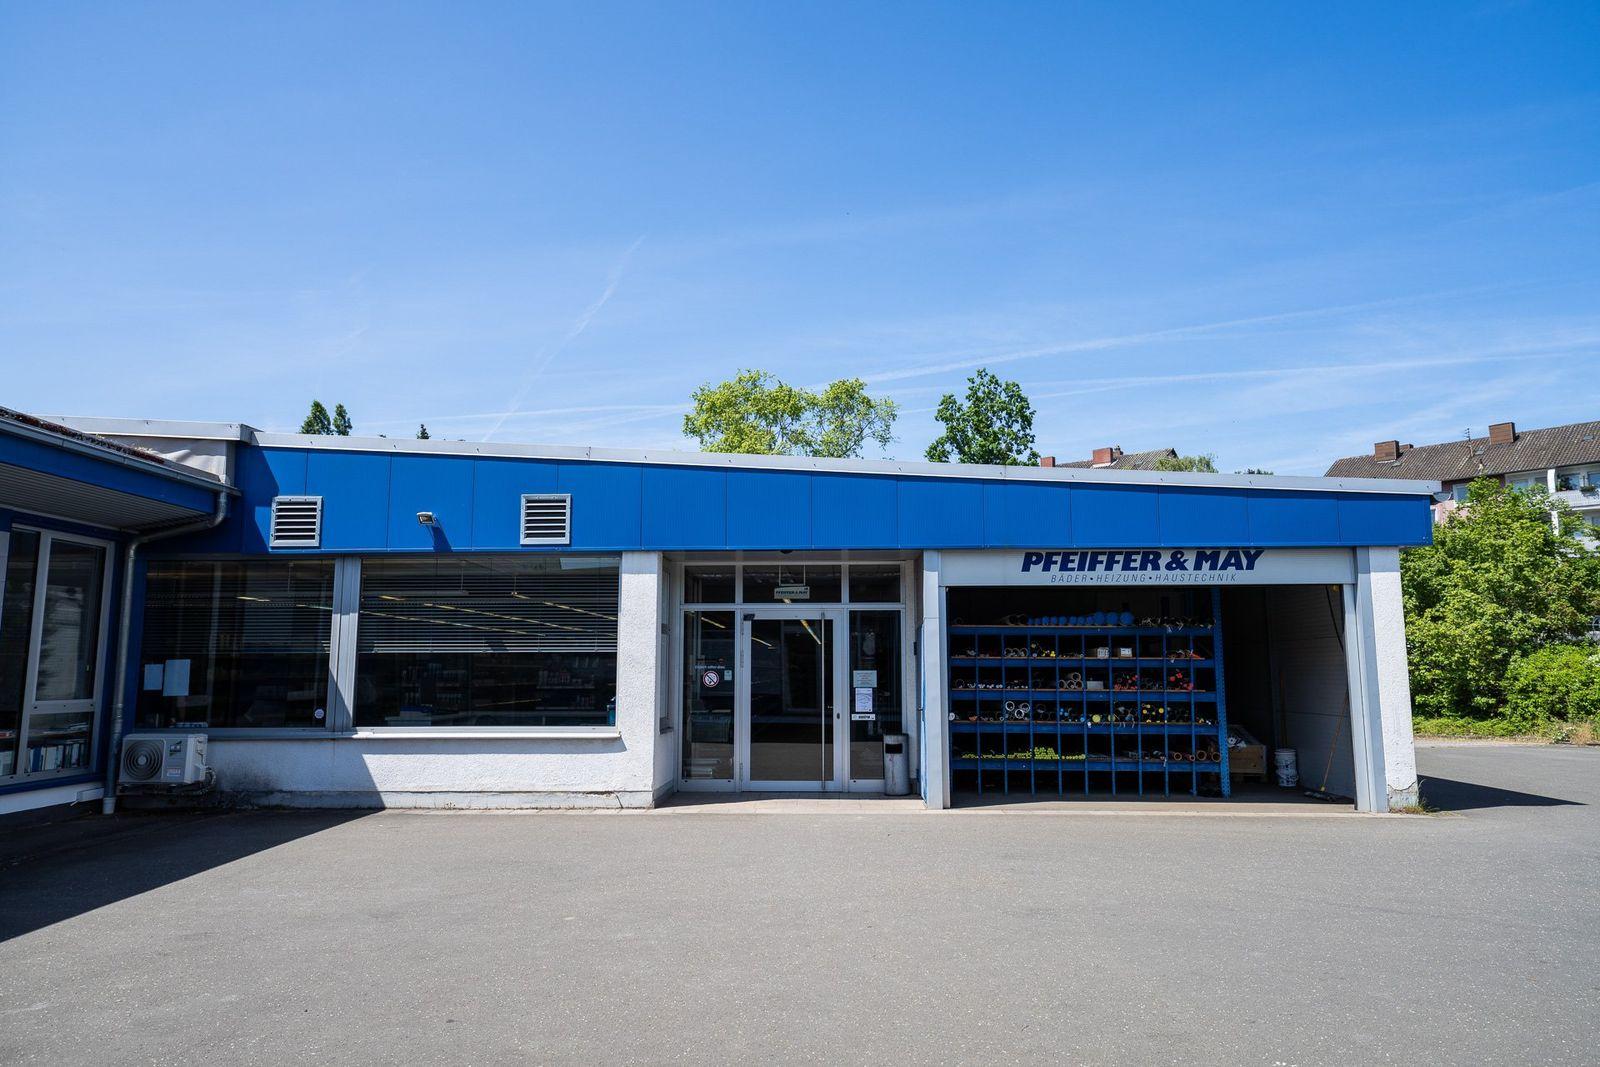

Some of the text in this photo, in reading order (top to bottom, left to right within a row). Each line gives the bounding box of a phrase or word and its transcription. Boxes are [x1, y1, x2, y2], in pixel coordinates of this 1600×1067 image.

[1021, 550, 1265, 572] PFEIFFER & MAY
[1096, 574, 1146, 583] HEIZUNG
[1155, 573, 1237, 582] HAUSTECHNIK
